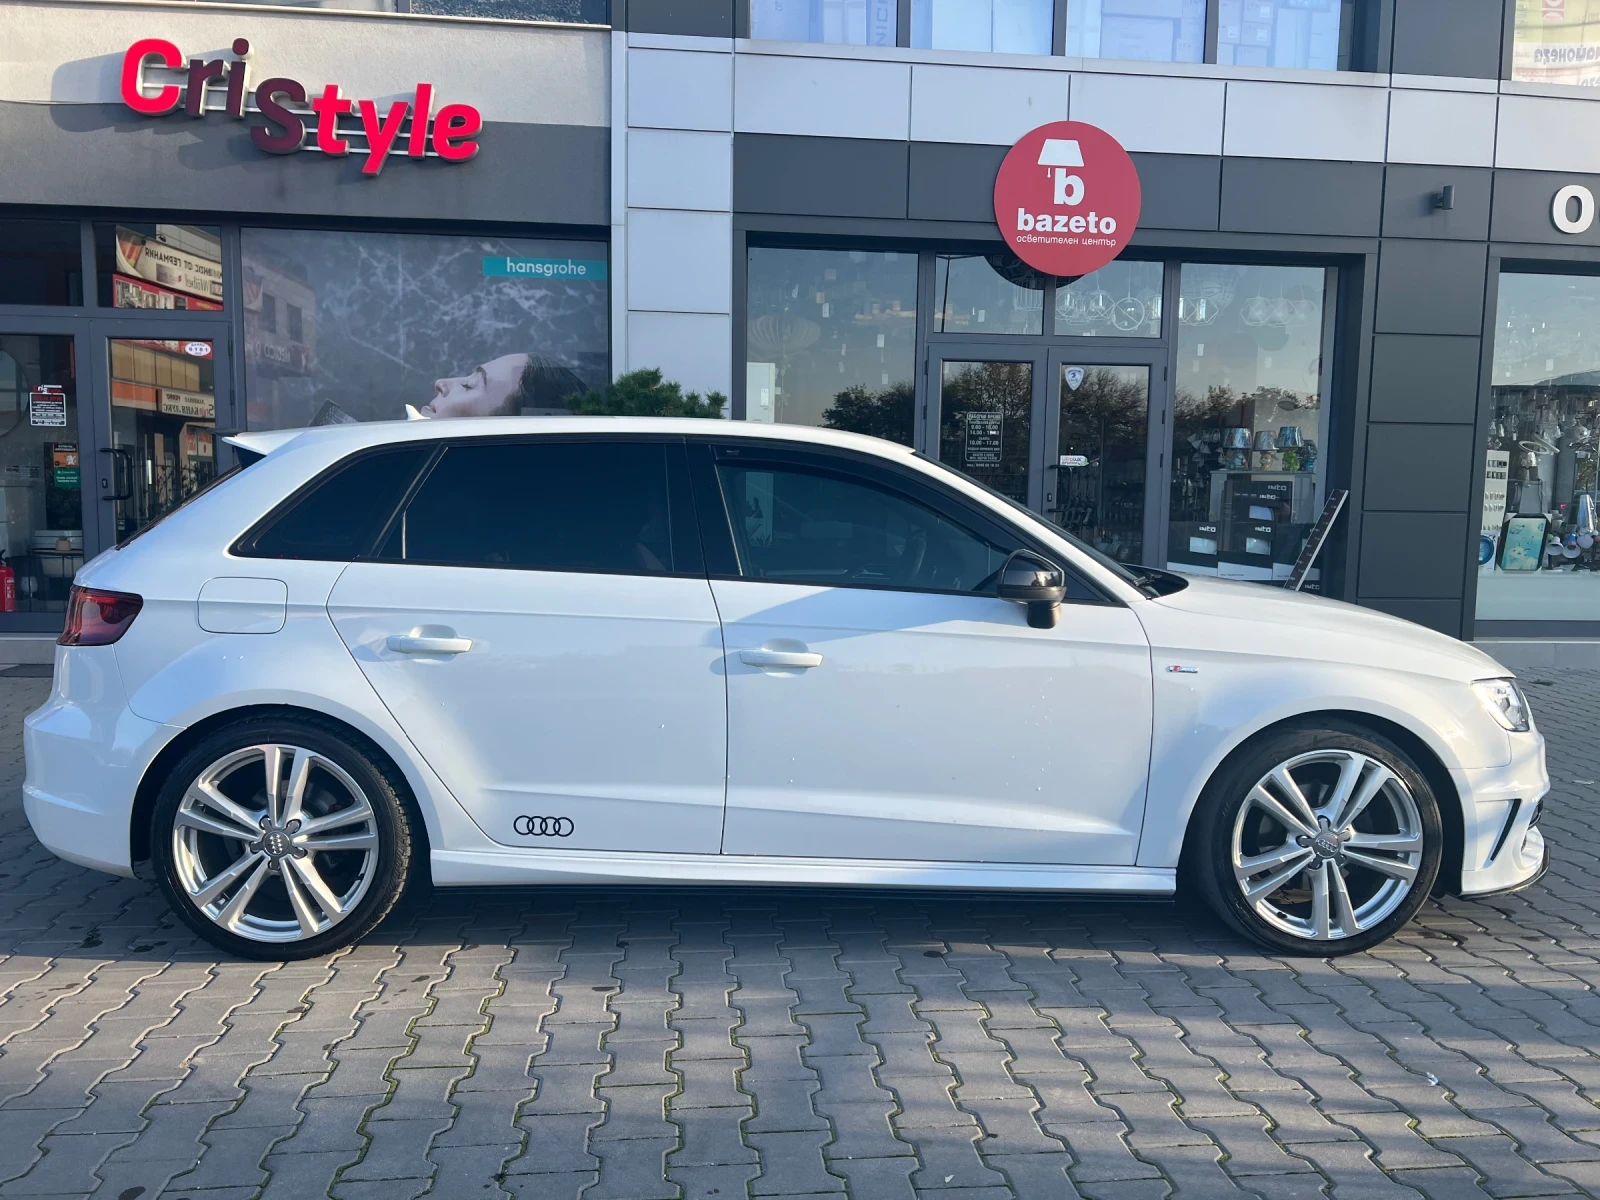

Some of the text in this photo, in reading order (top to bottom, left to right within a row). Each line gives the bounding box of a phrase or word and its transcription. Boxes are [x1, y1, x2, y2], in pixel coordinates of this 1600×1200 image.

[1016, 207, 1117, 235] bazeto
[1016, 234, 1117, 248] осветителен център
[505, 257, 587, 280] hansgrohe
